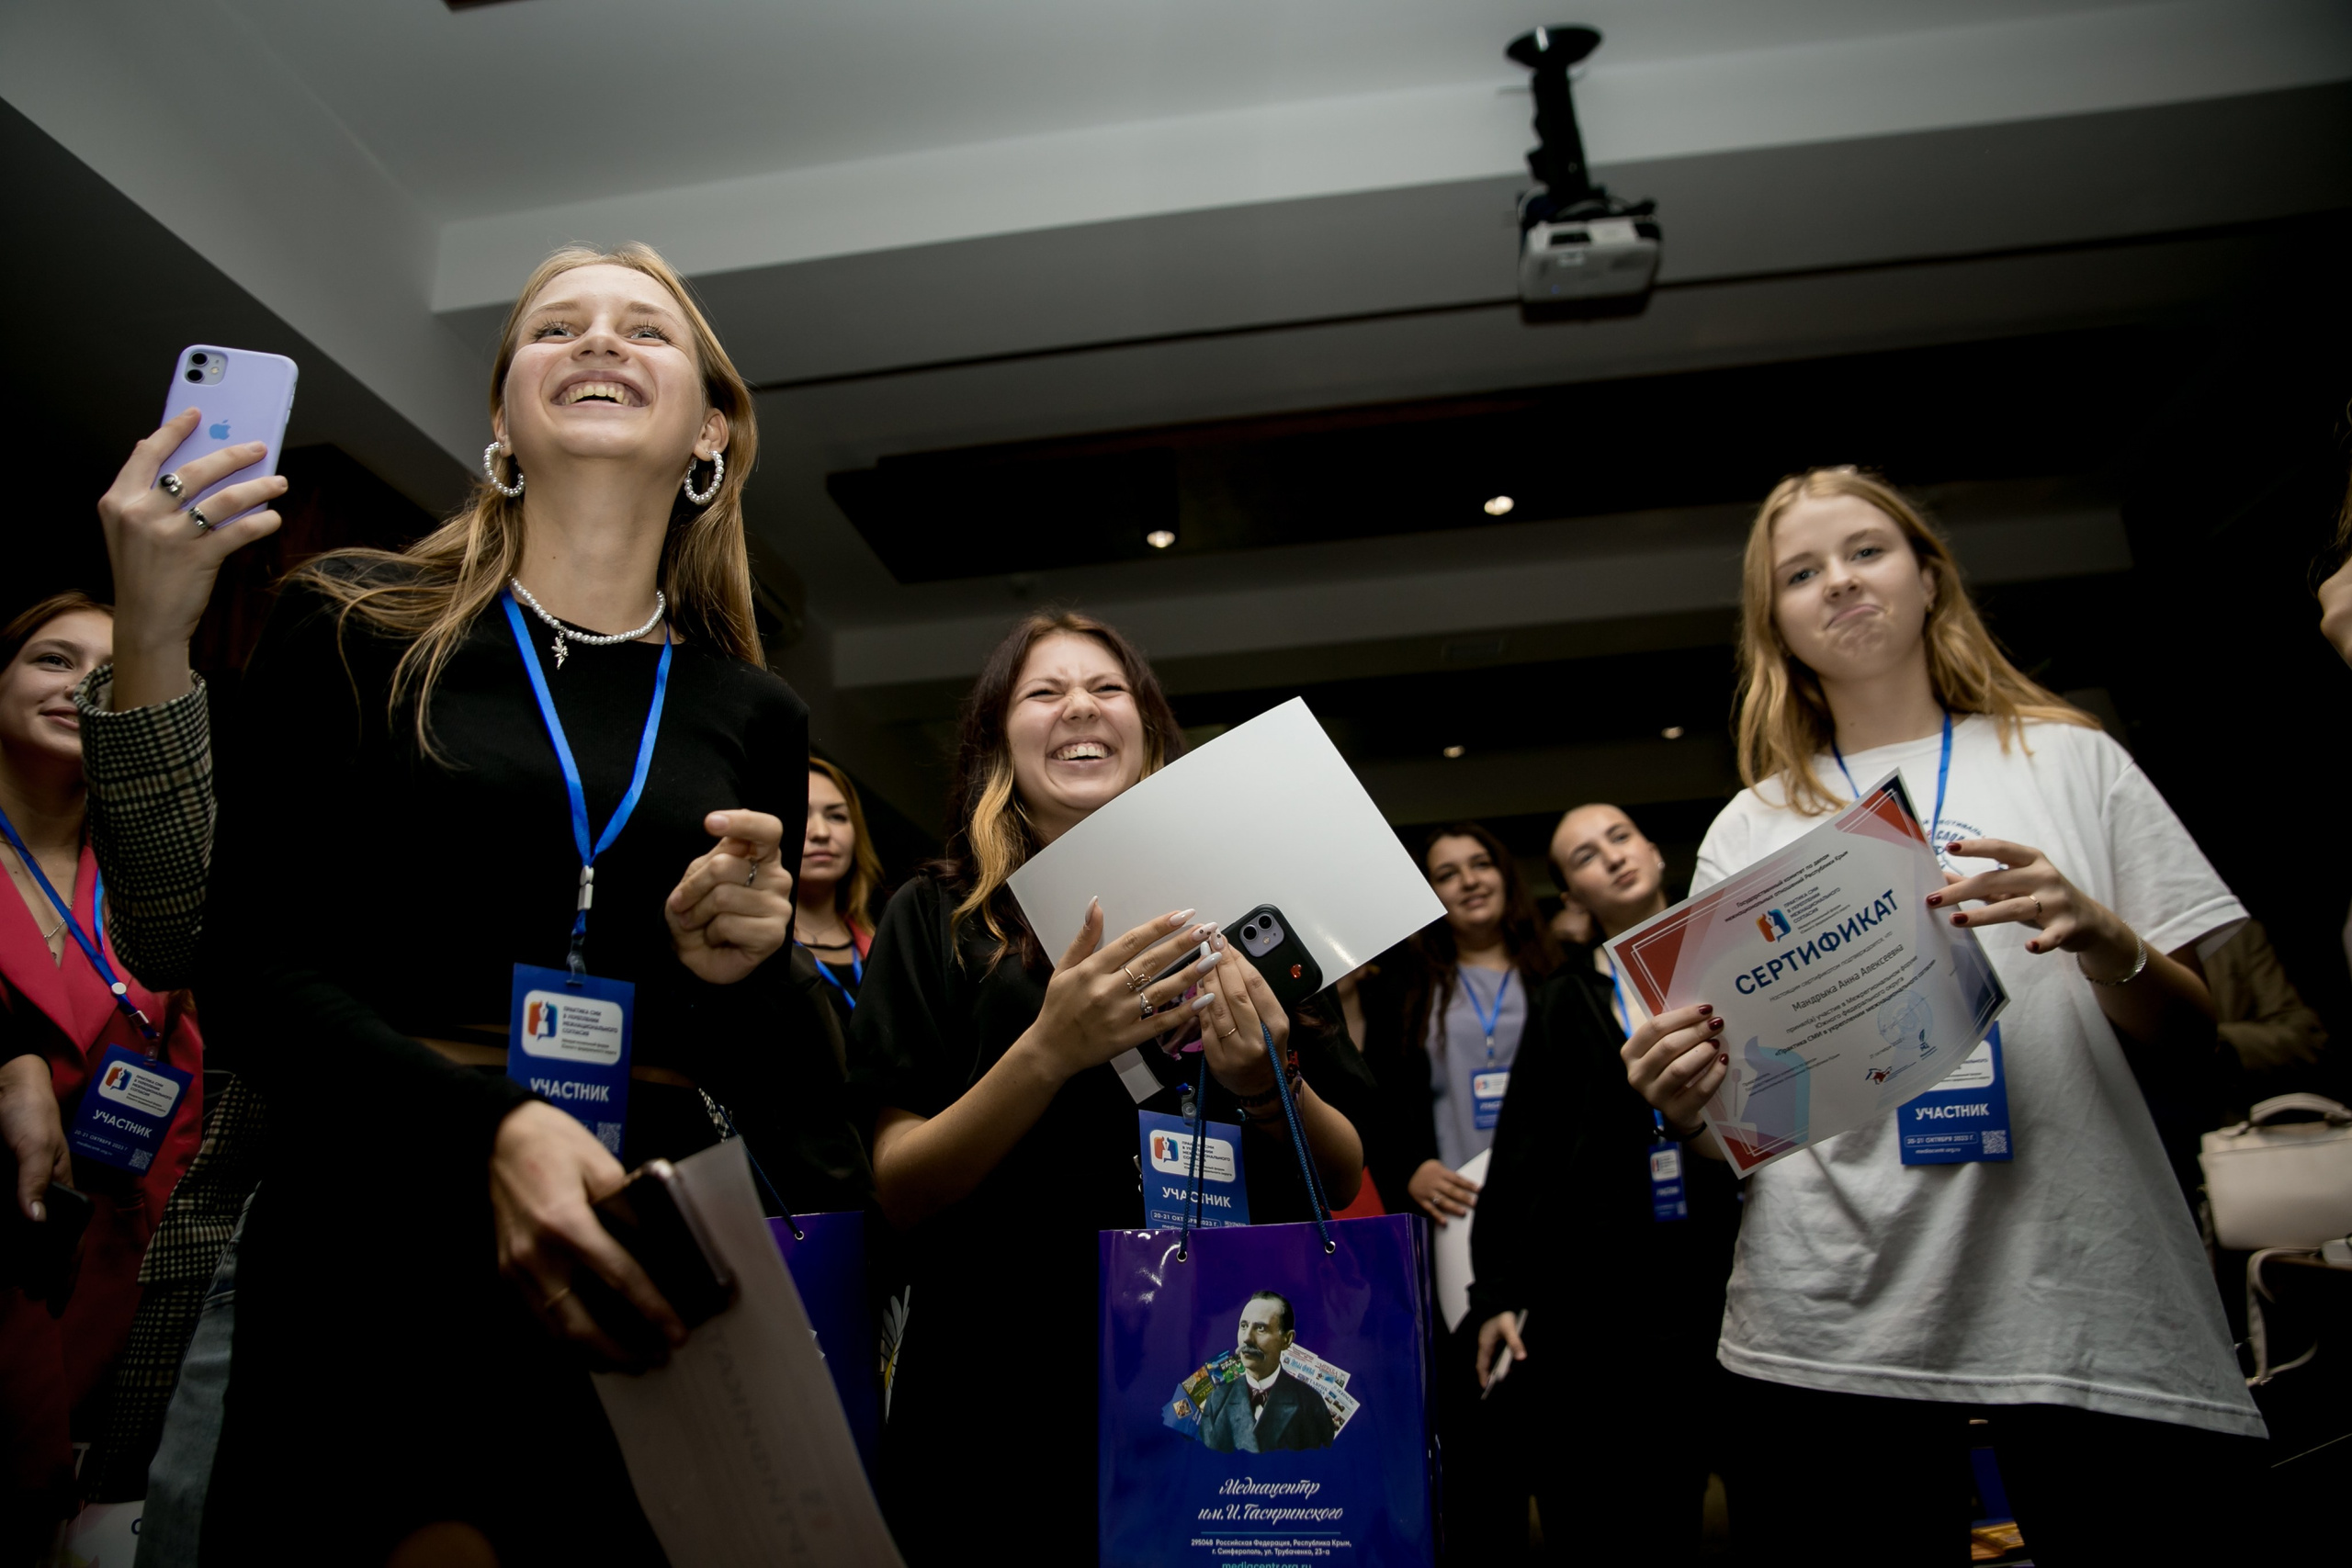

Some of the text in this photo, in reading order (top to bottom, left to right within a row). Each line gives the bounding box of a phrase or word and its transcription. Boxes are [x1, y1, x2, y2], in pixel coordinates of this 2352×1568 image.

[1736, 888, 1898, 995] СЕРТИФИКАТ
[1792, 942, 1904, 1011] Мандрыка Анна Алексеевна
[1815, 1003, 1840, 1021] участие
[1845, 968, 1900, 1004] Межрегиональном
[1815, 976, 1904, 1029] Южного федерального округа
[1806, 1030, 1823, 1043] СМИ
[1826, 1009, 1865, 1033] укреплении
[530, 1077, 610, 1101] УЧАСТНИК
[93, 1110, 153, 1138] УЧАСТНИК
[1916, 1103, 1990, 1121] УЧАСТНИК
[1171, 1214, 1197, 1224] ОКТБРЯ
[1219, 1476, 1320, 1500] Медиацентр
[1243, 1504, 1343, 1526] Гаспринского
[1191, 1539, 1351, 1548] 295048 Российская Федерация, Республика Крым,
[1217, 1548, 1262, 1556] Симферополь,
[1274, 1548, 1314, 1556] Трубаченко,
